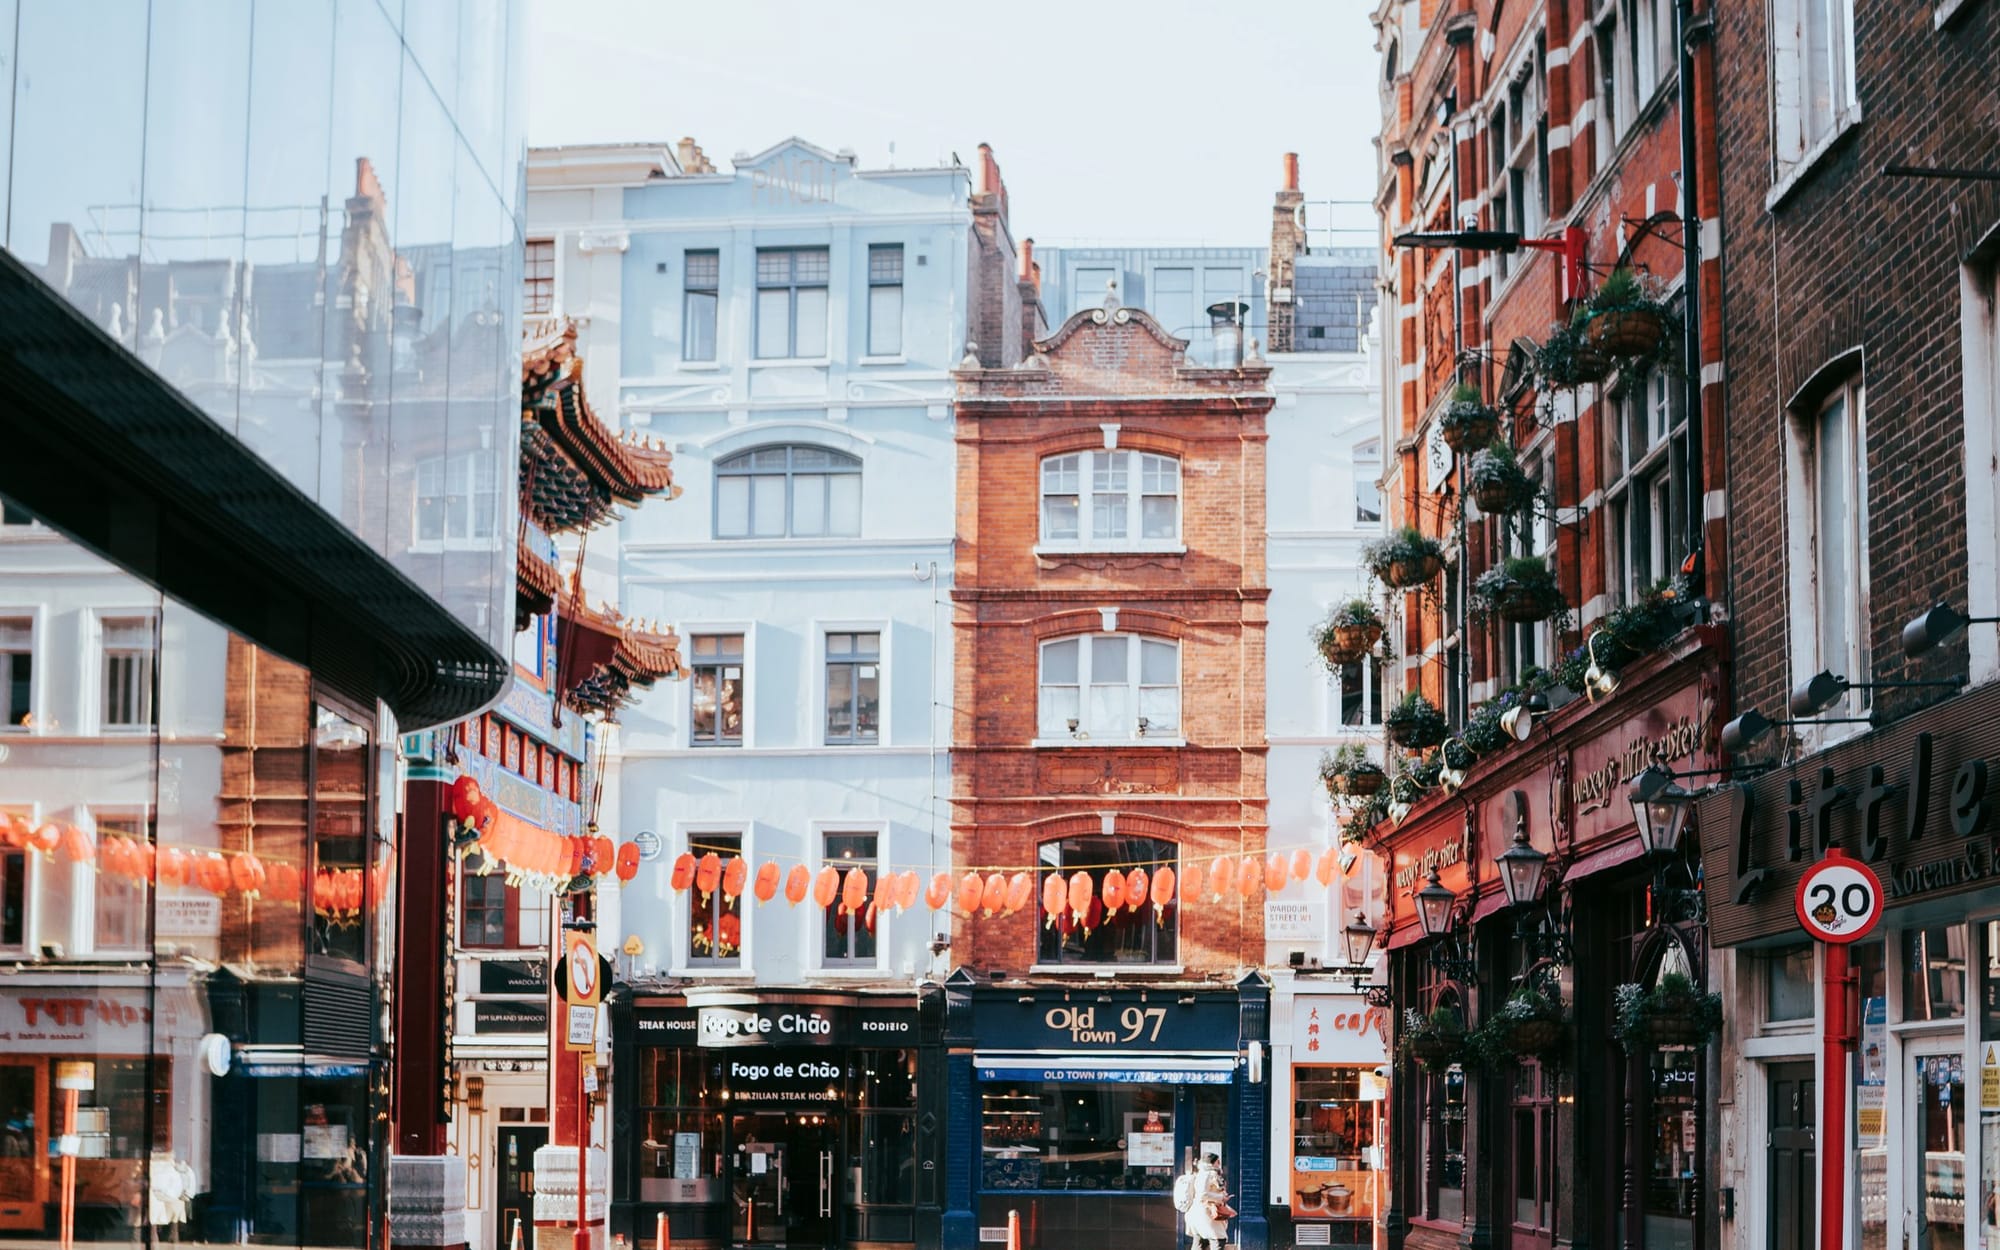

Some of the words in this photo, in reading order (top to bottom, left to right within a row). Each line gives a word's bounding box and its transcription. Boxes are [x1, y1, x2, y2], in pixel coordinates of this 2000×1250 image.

[1889, 858, 1957, 897] Korean
[1962, 843, 1979, 881] &
[1810, 883, 1870, 917] 20
[639, 1020, 664, 1030] STEAK
[666, 1020, 697, 1030] HOUSE
[744, 1012, 772, 1033] de
[778, 1013, 831, 1034] Chão
[1045, 1006, 1095, 1029] Old
[1120, 1007, 1167, 1042] 97
[1069, 1027, 1117, 1043] Town
[732, 1062, 769, 1080] Fogo
[773, 1062, 794, 1077] de
[798, 1061, 840, 1078] Chão
[1044, 1070, 1065, 1079] OLD
[1066, 1070, 1095, 1079] TOWN
[734, 1091, 779, 1101] BRAZILIAN
[780, 1091, 807, 1101] STEAK
